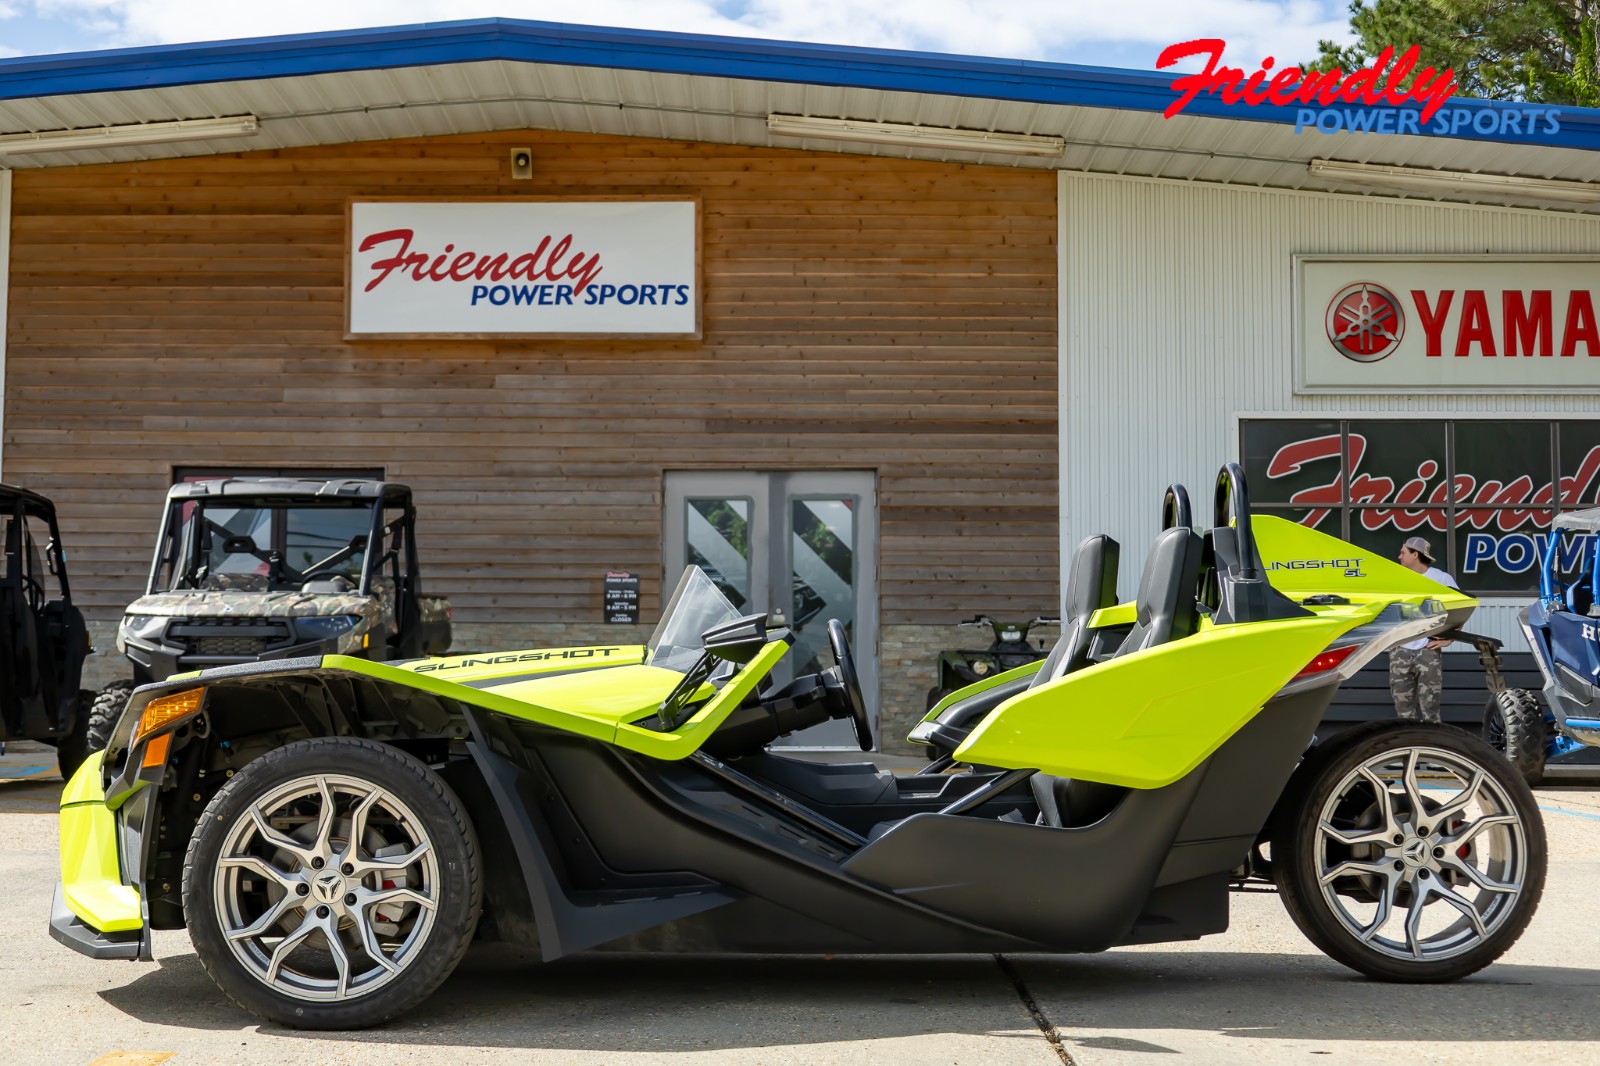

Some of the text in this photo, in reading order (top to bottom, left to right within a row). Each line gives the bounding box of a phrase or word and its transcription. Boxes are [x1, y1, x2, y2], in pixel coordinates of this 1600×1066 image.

[358, 229, 603, 297] Friendly
[471, 285, 690, 306] POWER SPORTS
[1410, 290, 1600, 356] YAMA
[1267, 433, 1600, 532] Friend
[1344, 568, 1367, 578] SL
[414, 648, 620, 672] SLINGSHOT
